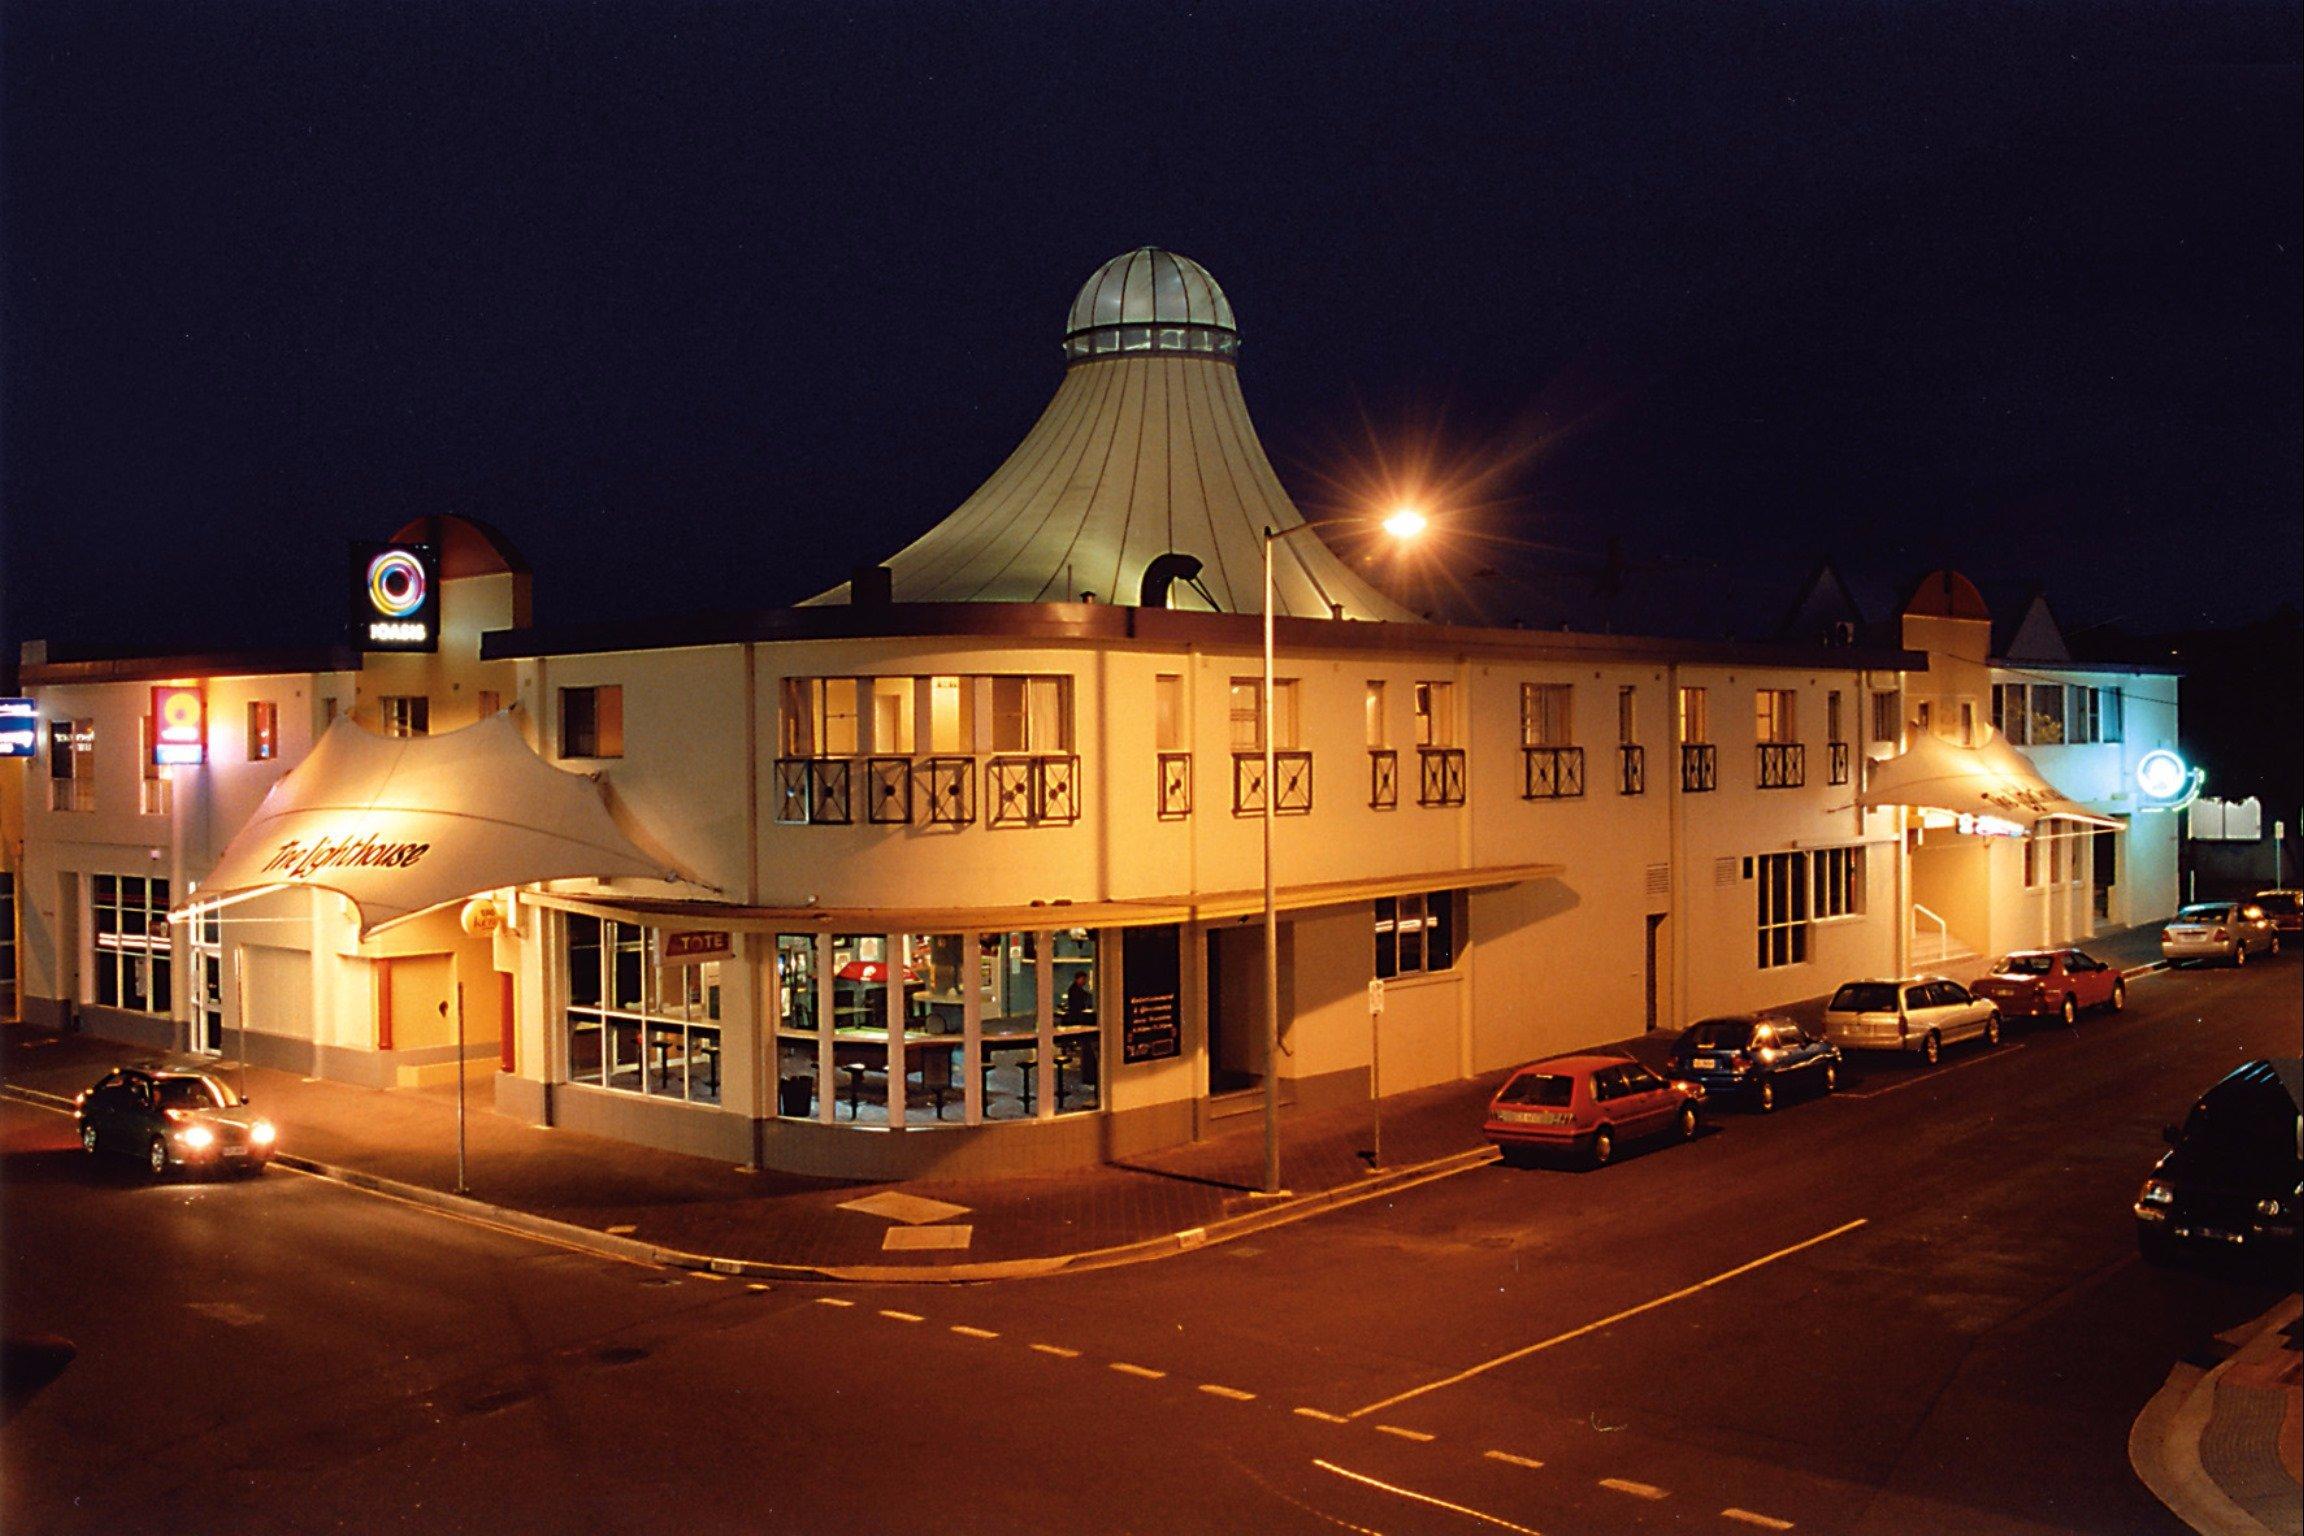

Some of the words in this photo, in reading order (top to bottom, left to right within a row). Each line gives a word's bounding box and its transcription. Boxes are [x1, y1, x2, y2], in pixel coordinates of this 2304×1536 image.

[261, 839, 307, 873] The
[289, 832, 431, 878] Lighthouse
[680, 934, 723, 951] TOTE
